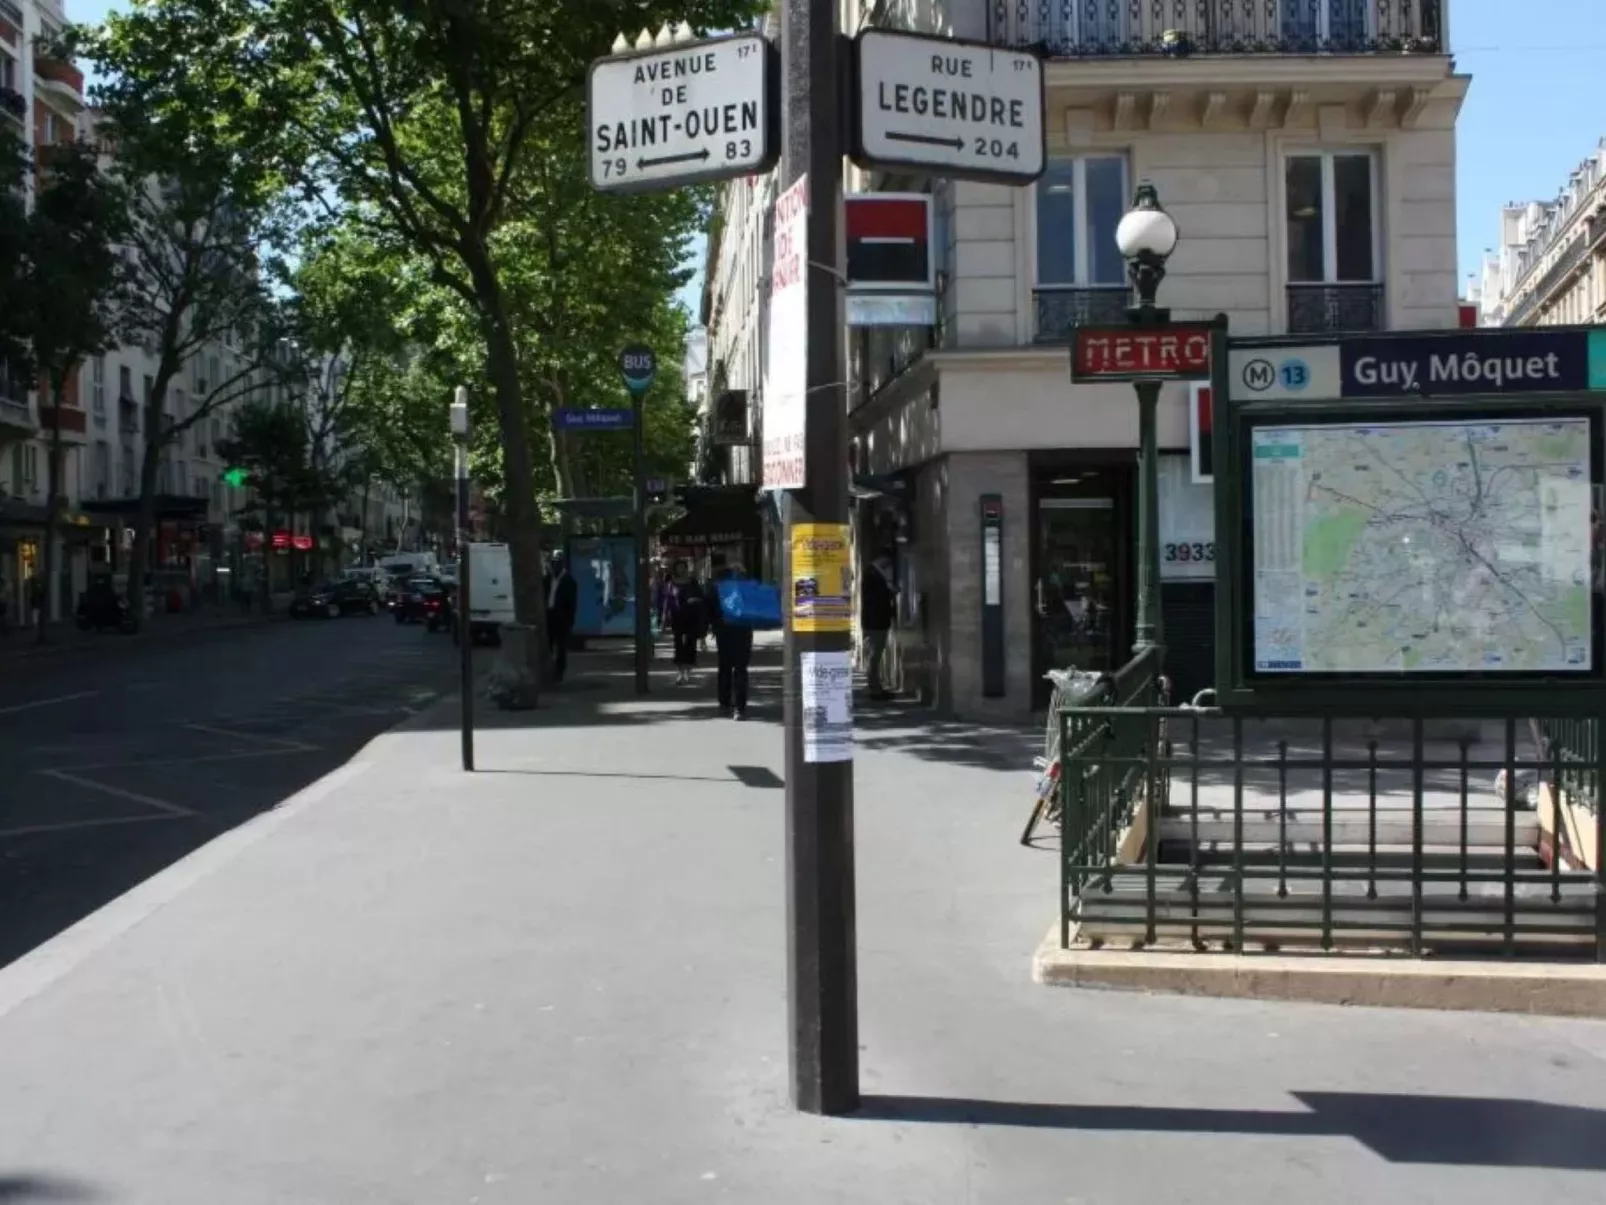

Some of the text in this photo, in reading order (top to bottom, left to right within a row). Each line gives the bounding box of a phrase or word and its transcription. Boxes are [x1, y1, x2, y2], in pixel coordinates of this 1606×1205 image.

[634, 53, 716, 84] AVENUE
[931, 55, 973, 78] RUE
[661, 85, 688, 106] DE
[878, 81, 1024, 128] LEGENDRE
[596, 101, 758, 153] SAINT-OUEN
[602, 139, 752, 179] 79 83
[974, 137, 1020, 159] 204
[623, 354, 652, 369] BUS
[1086, 335, 1207, 367] METRO
[1281, 364, 1306, 386] 13
[1354, 352, 1559, 390] Guy Môquet
